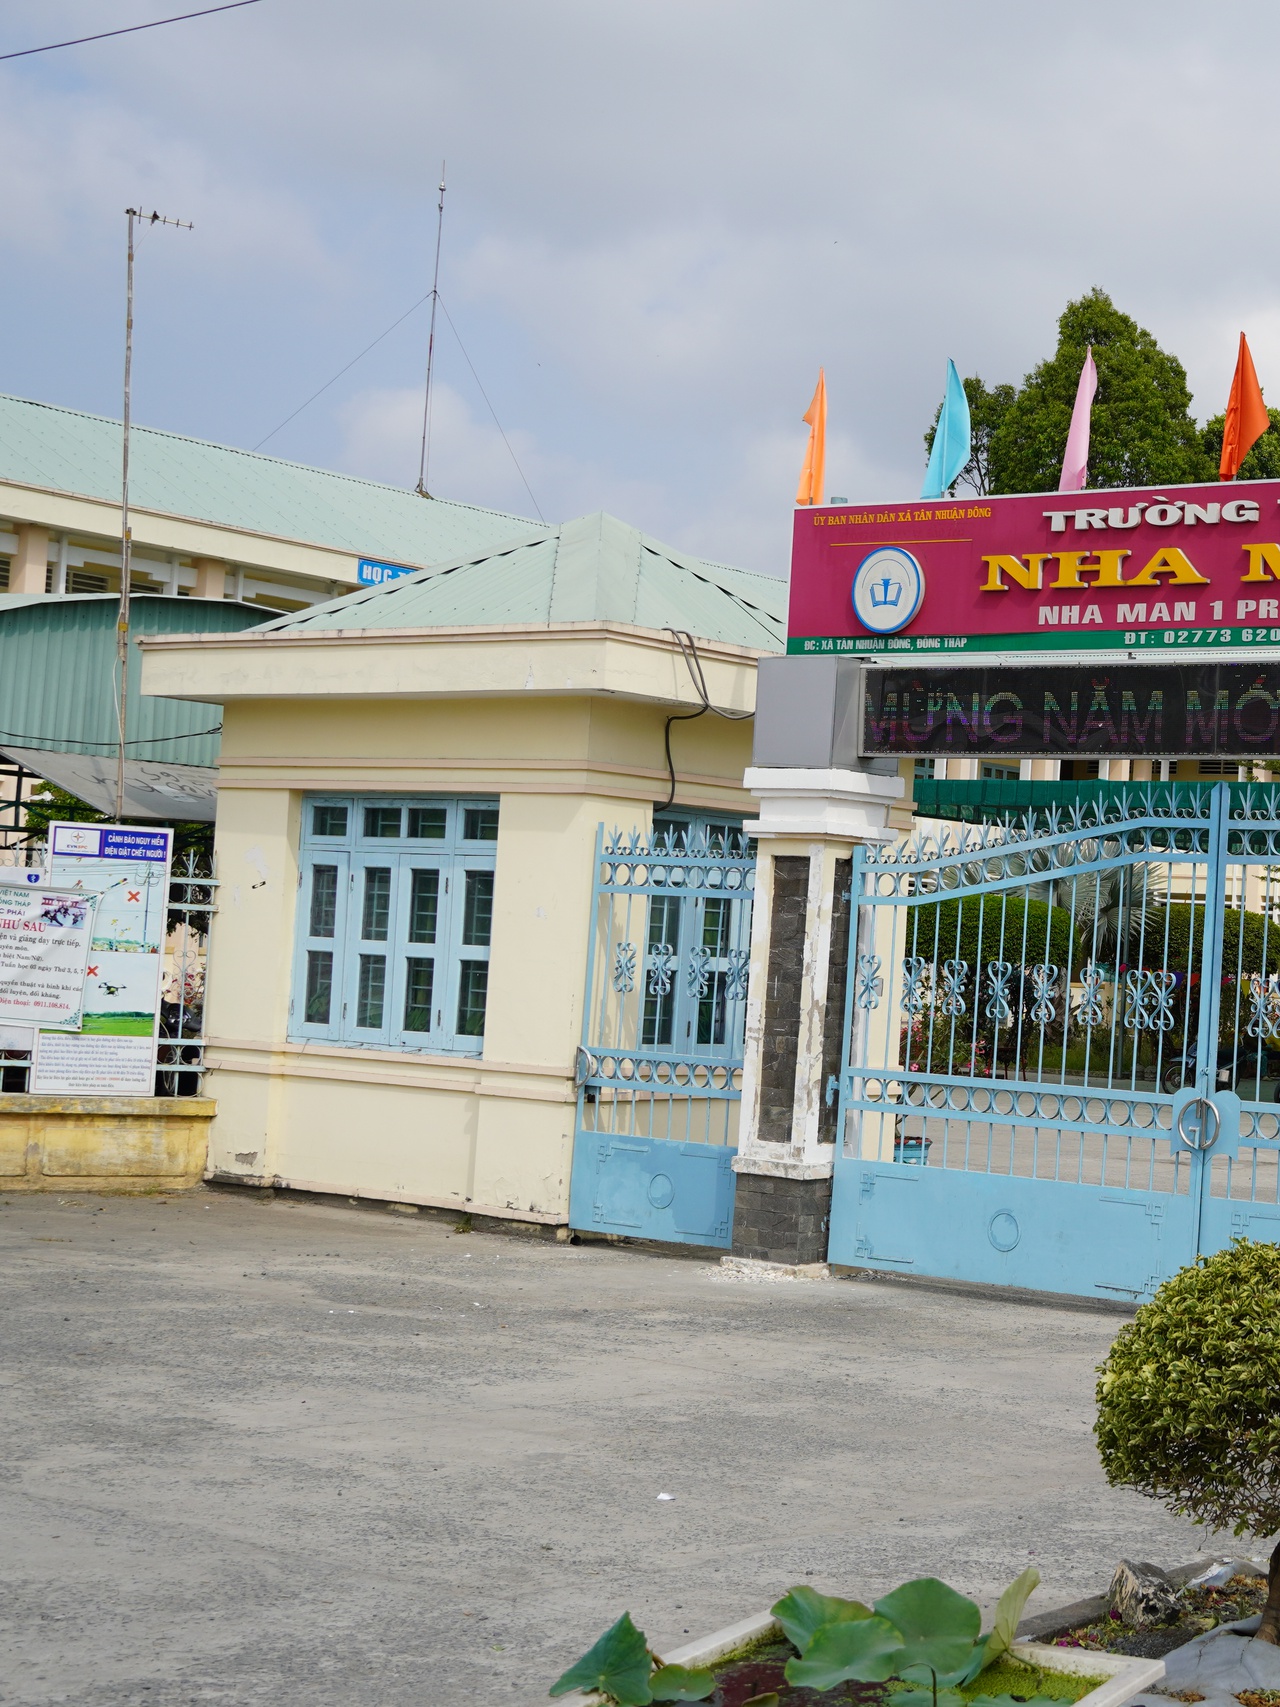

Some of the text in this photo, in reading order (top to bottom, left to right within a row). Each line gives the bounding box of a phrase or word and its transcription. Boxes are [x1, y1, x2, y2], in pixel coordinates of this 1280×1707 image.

[814, 506, 992, 526] ỦY BAN NHÂN DÂN XÃ TÂN NHUẬN ĐÔNG
[1042, 496, 1260, 532] TRƯỜNG
[980, 546, 1210, 592] NHA
[1038, 604, 1103, 626] NHA
[1116, 602, 1196, 623] MAN
[1210, 600, 1223, 621] 1
[820, 639, 834, 650] XÃ
[836, 638, 853, 650] TÂN
[856, 638, 884, 652] NHUẬN
[1124, 632, 1155, 644] ĐT:
[1163, 630, 1232, 644] 02773
[1044, 677, 1163, 744] NĂM
